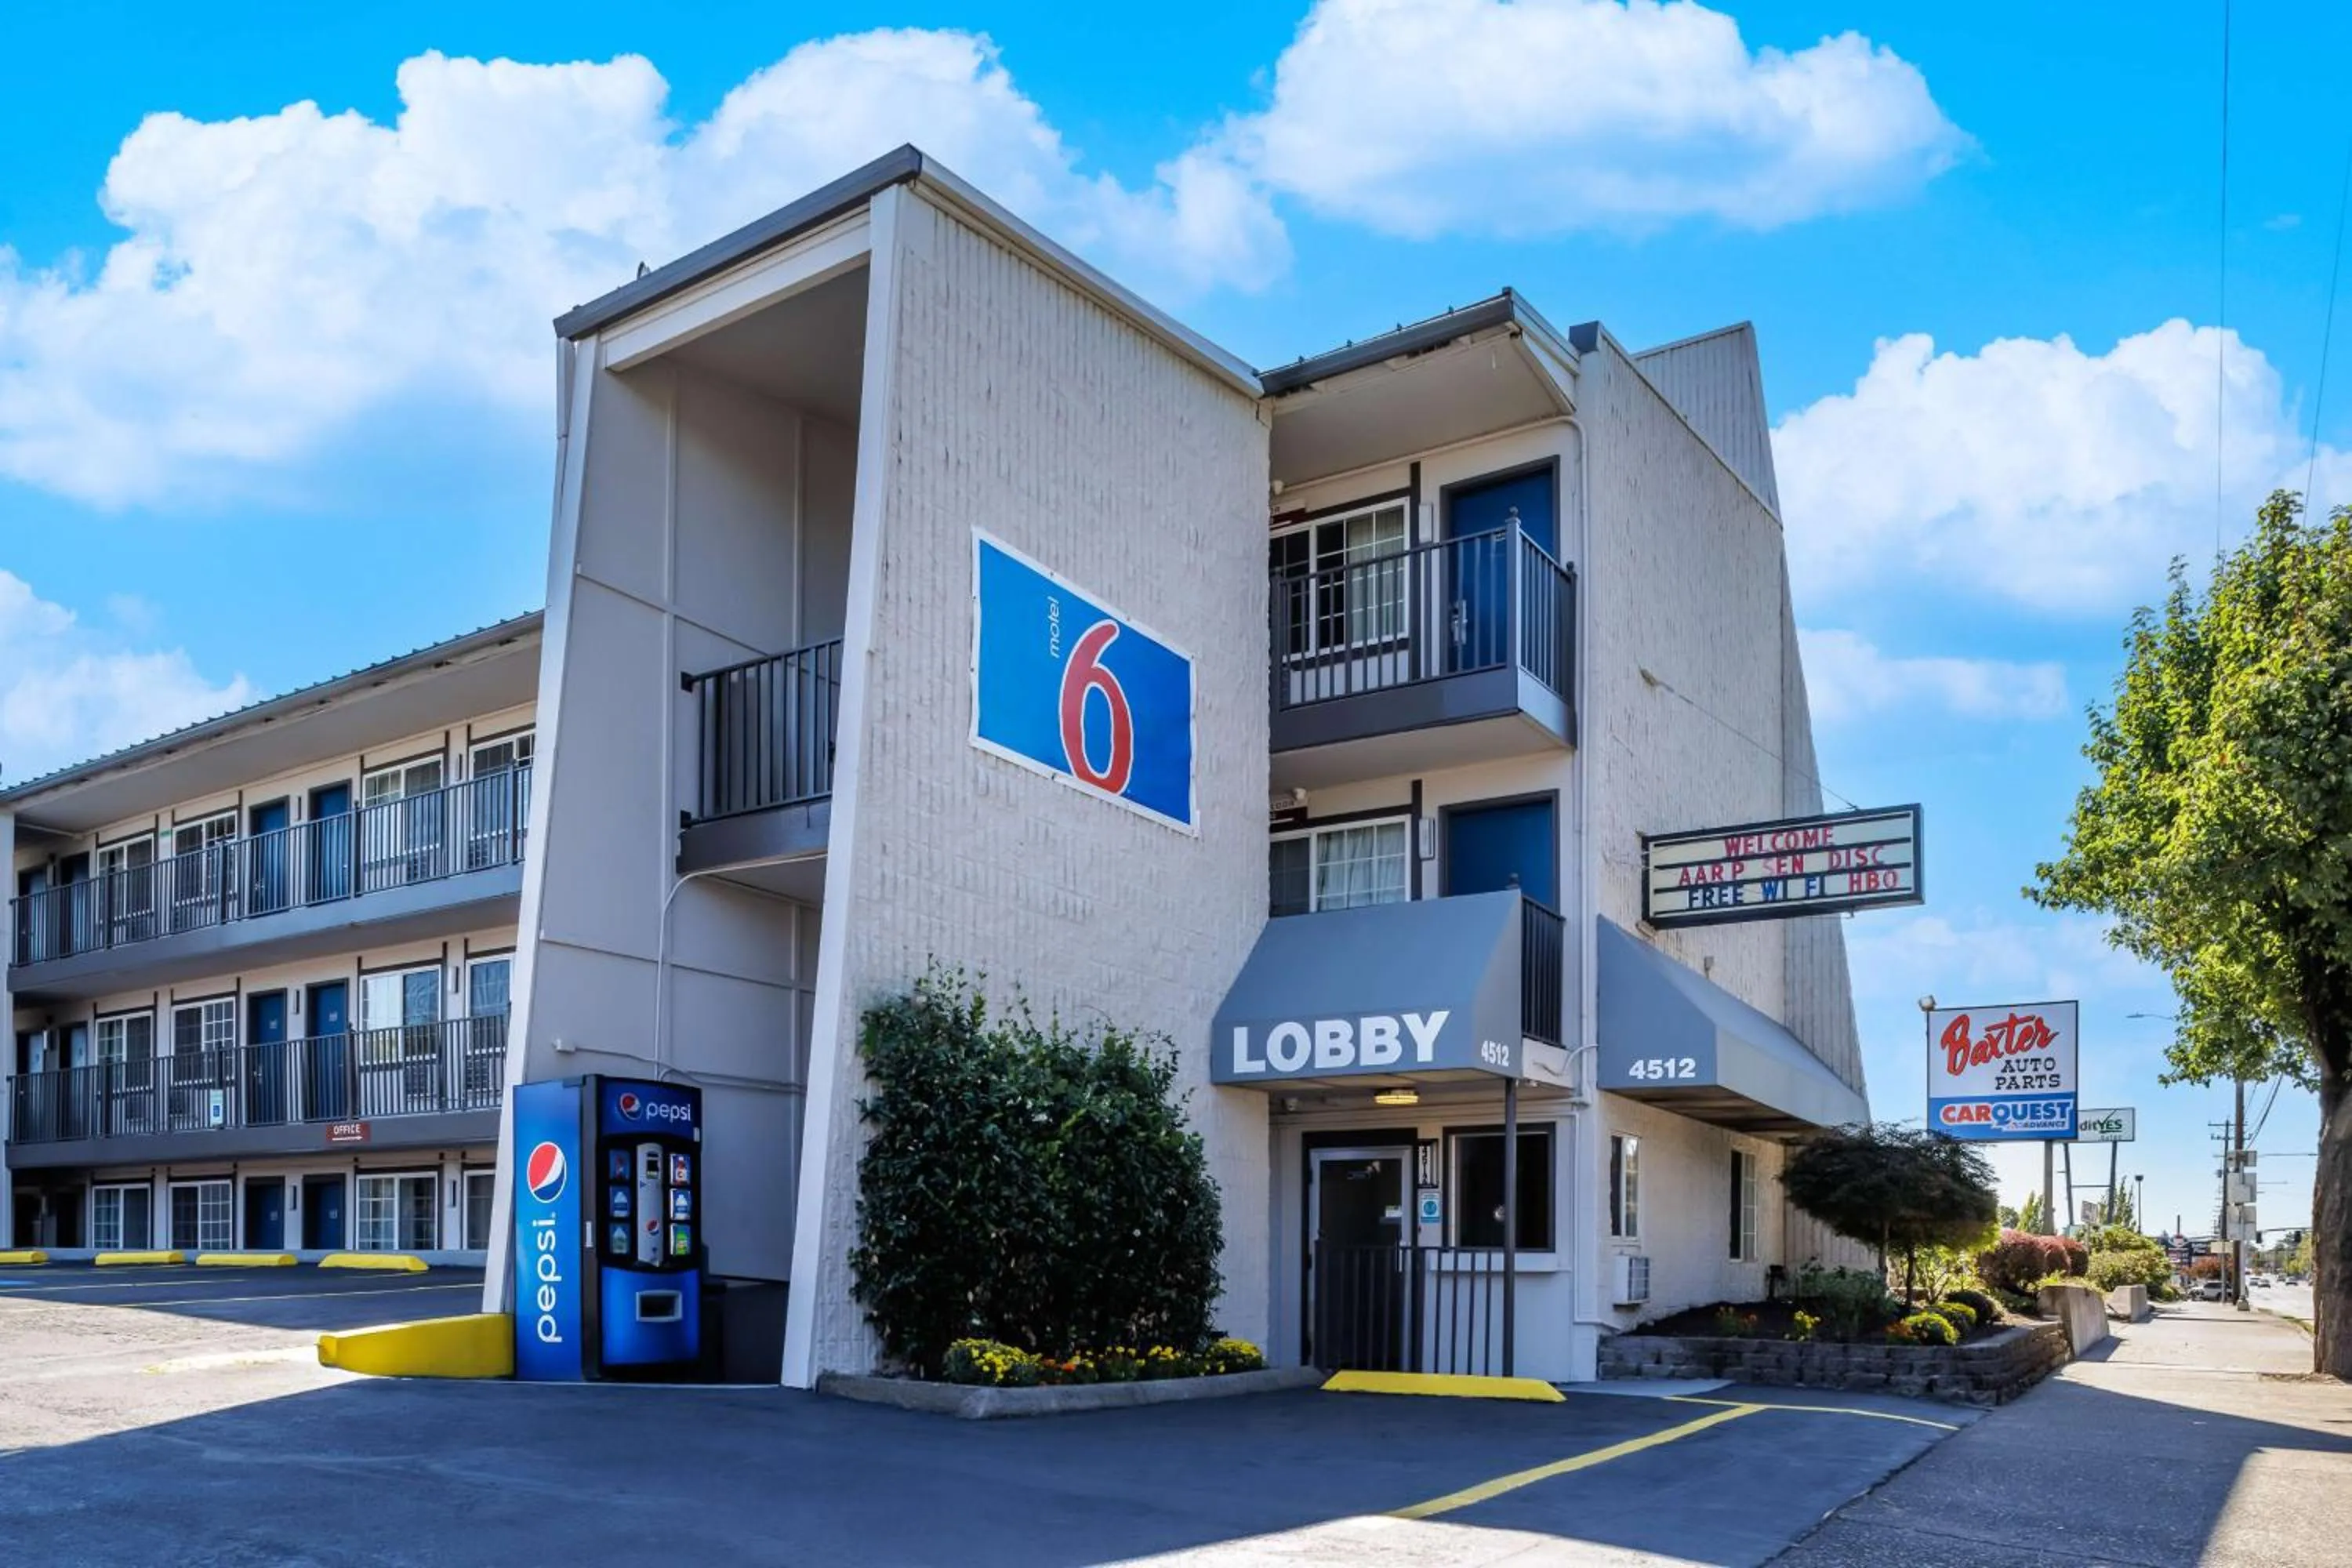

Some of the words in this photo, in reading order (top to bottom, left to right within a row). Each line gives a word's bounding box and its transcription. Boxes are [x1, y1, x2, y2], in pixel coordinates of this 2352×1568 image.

[1047, 596, 1060, 659] motel
[1059, 619, 1134, 797] 6
[1725, 825, 1834, 857] WELCOME
[1679, 860, 1744, 886] AARP
[1829, 845, 1884, 869] DISC
[1689, 884, 1744, 909] FREE
[1848, 869, 1898, 895] HBO
[1233, 1011, 1450, 1073] LOBBY
[1481, 1040, 1509, 1067] 4512
[1940, 1013, 2060, 1076] Baxter
[1628, 1058, 1696, 1080] 4512
[2001, 1057, 2056, 1073] AUTO
[1994, 1074, 2060, 1091] PARTS
[646, 1100, 691, 1123] pepsi
[1942, 1102, 2071, 1125] CARQUEST
[2022, 1120, 2066, 1129] ADVANCE
[2079, 1113, 2122, 1131] ditYES
[333, 1123, 361, 1135] OFFICE
[532, 1218, 563, 1344] pepsi
